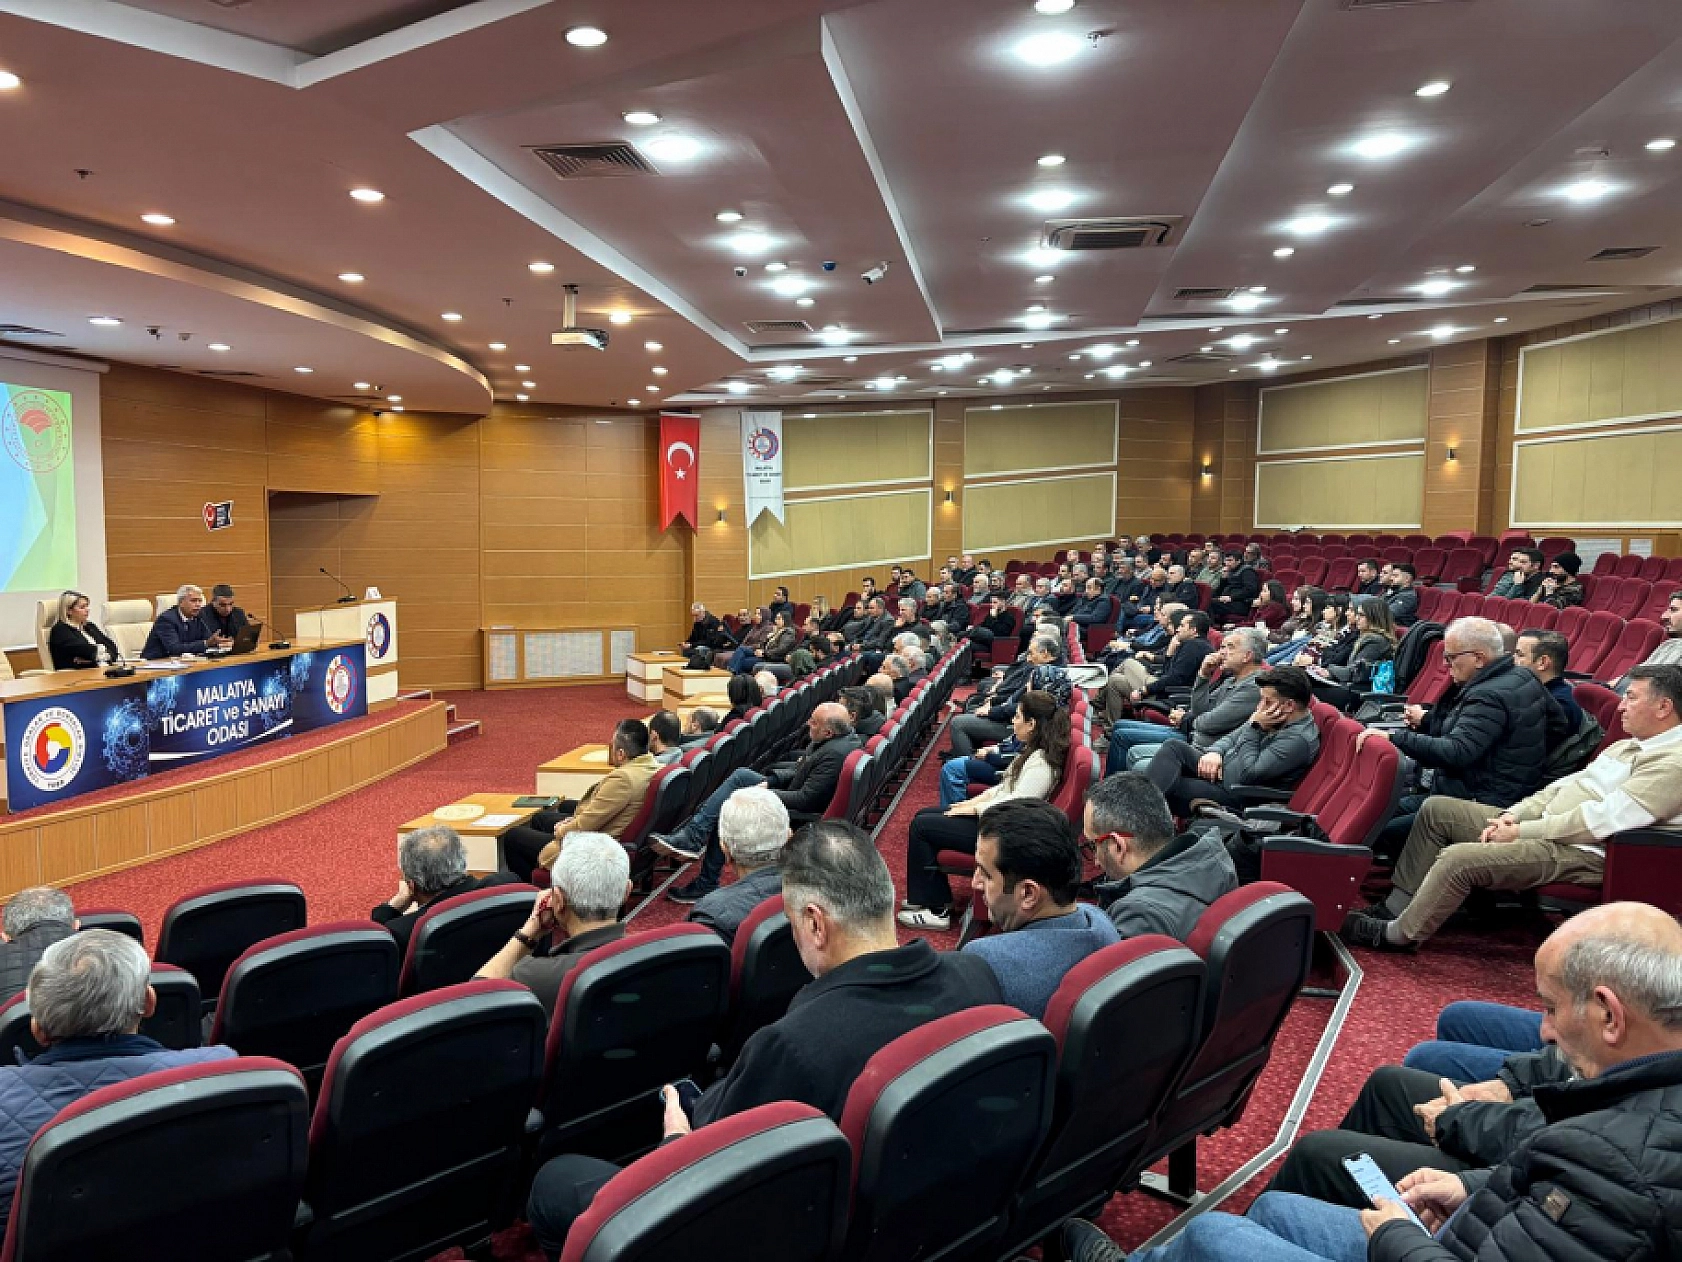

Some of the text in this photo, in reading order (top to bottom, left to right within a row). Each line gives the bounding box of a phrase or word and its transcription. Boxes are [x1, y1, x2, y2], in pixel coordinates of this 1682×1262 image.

[196, 678, 256, 706] MALATYA
[162, 706, 219, 736] TİCARET
[222, 706, 240, 721] ve
[207, 720, 249, 746] ODASI
